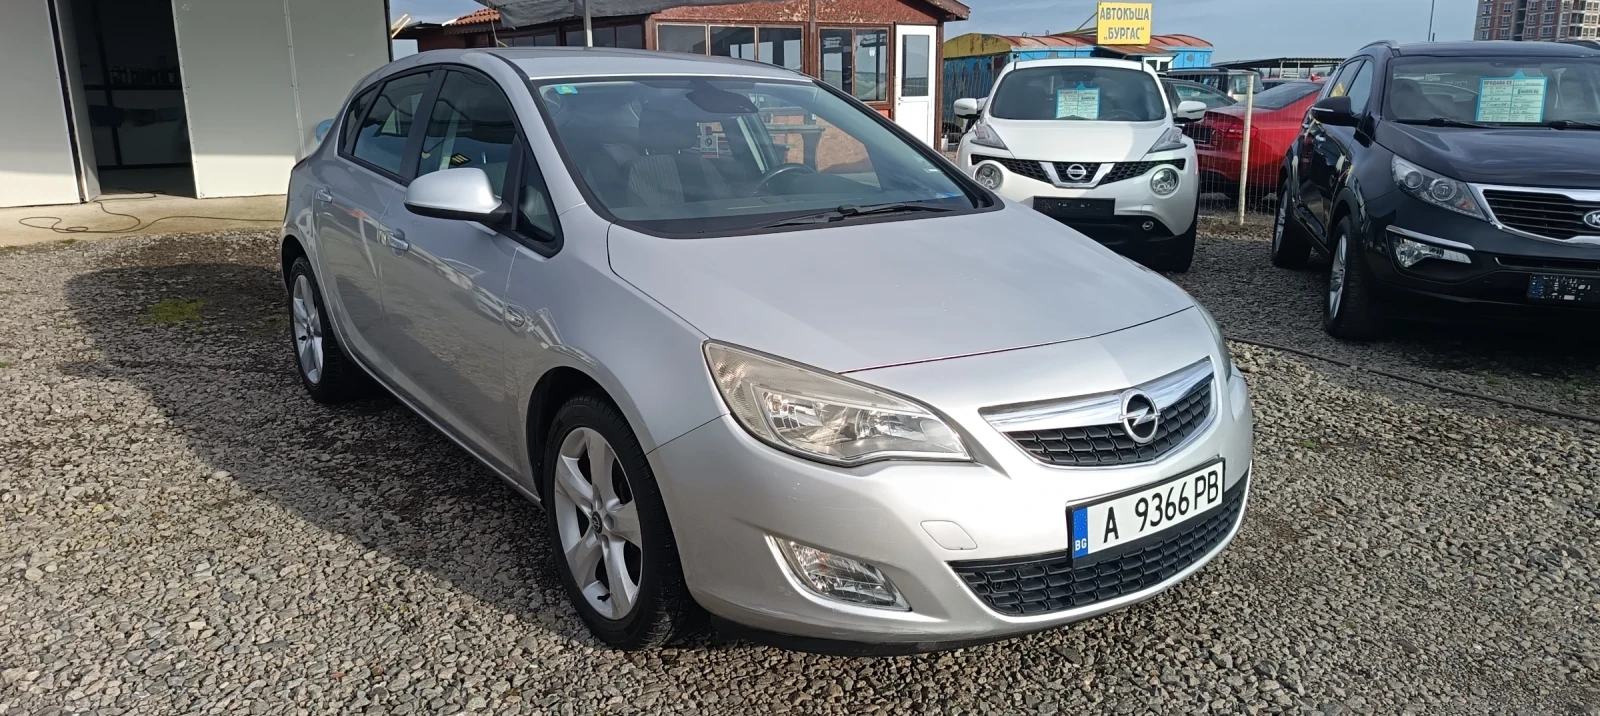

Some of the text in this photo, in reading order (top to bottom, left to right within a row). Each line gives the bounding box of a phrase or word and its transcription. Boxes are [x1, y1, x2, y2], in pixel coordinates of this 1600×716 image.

[1100, 7, 1150, 20] АВТОКЪША
[1103, 470, 1219, 544] A 9366 PB
[1074, 538, 1087, 551] BG
